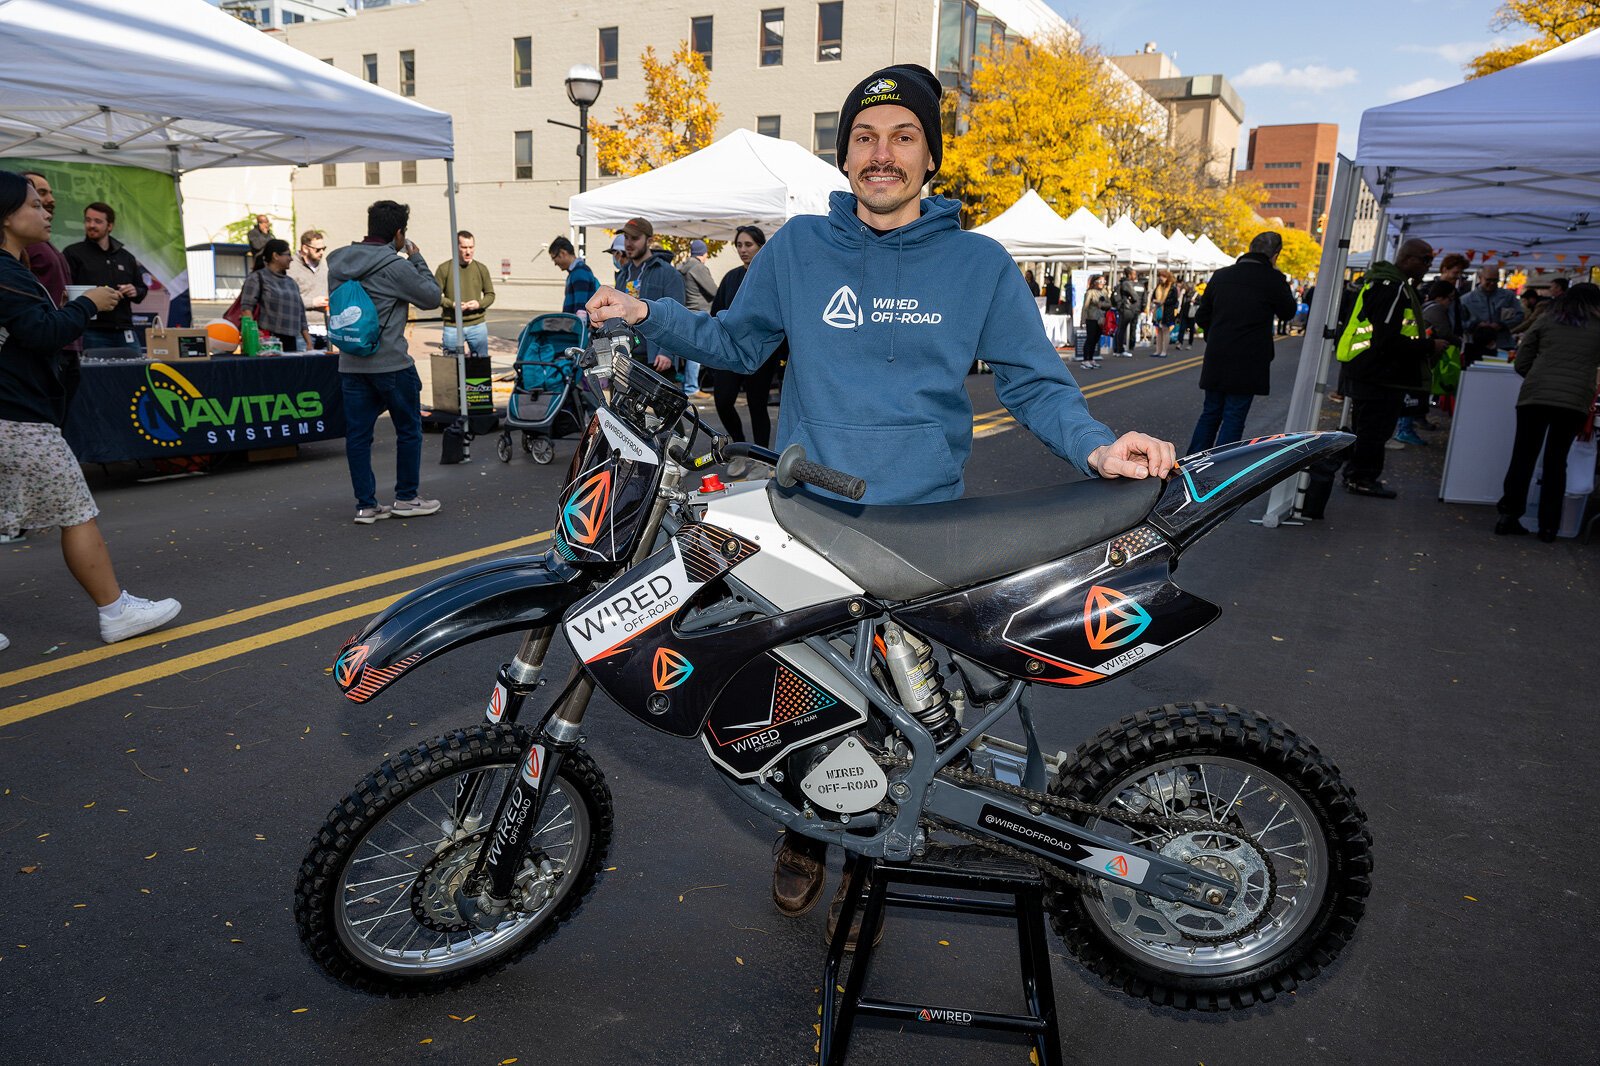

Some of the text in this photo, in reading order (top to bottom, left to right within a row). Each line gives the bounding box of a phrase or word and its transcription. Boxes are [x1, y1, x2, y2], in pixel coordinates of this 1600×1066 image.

[861, 94, 901, 107] FOOTBALL
[873, 298, 919, 310] WIRED
[207, 420, 325, 444] SYSTEMS
[604, 419, 643, 457] @WIREDOFFROAD
[572, 575, 673, 642] WIRED
[624, 595, 679, 633] OFF-ROAD
[1101, 646, 1144, 671] WIRED
[731, 729, 780, 754] WIRED
[826, 766, 865, 780] WIRED
[817, 779, 878, 794] OFF-ROAD
[488, 786, 523, 866] WIRED
[509, 798, 532, 845] OFF-ROAD
[985, 814, 1072, 851] @WIREDOFFROAD
[930, 1009, 972, 1023] WIRED
